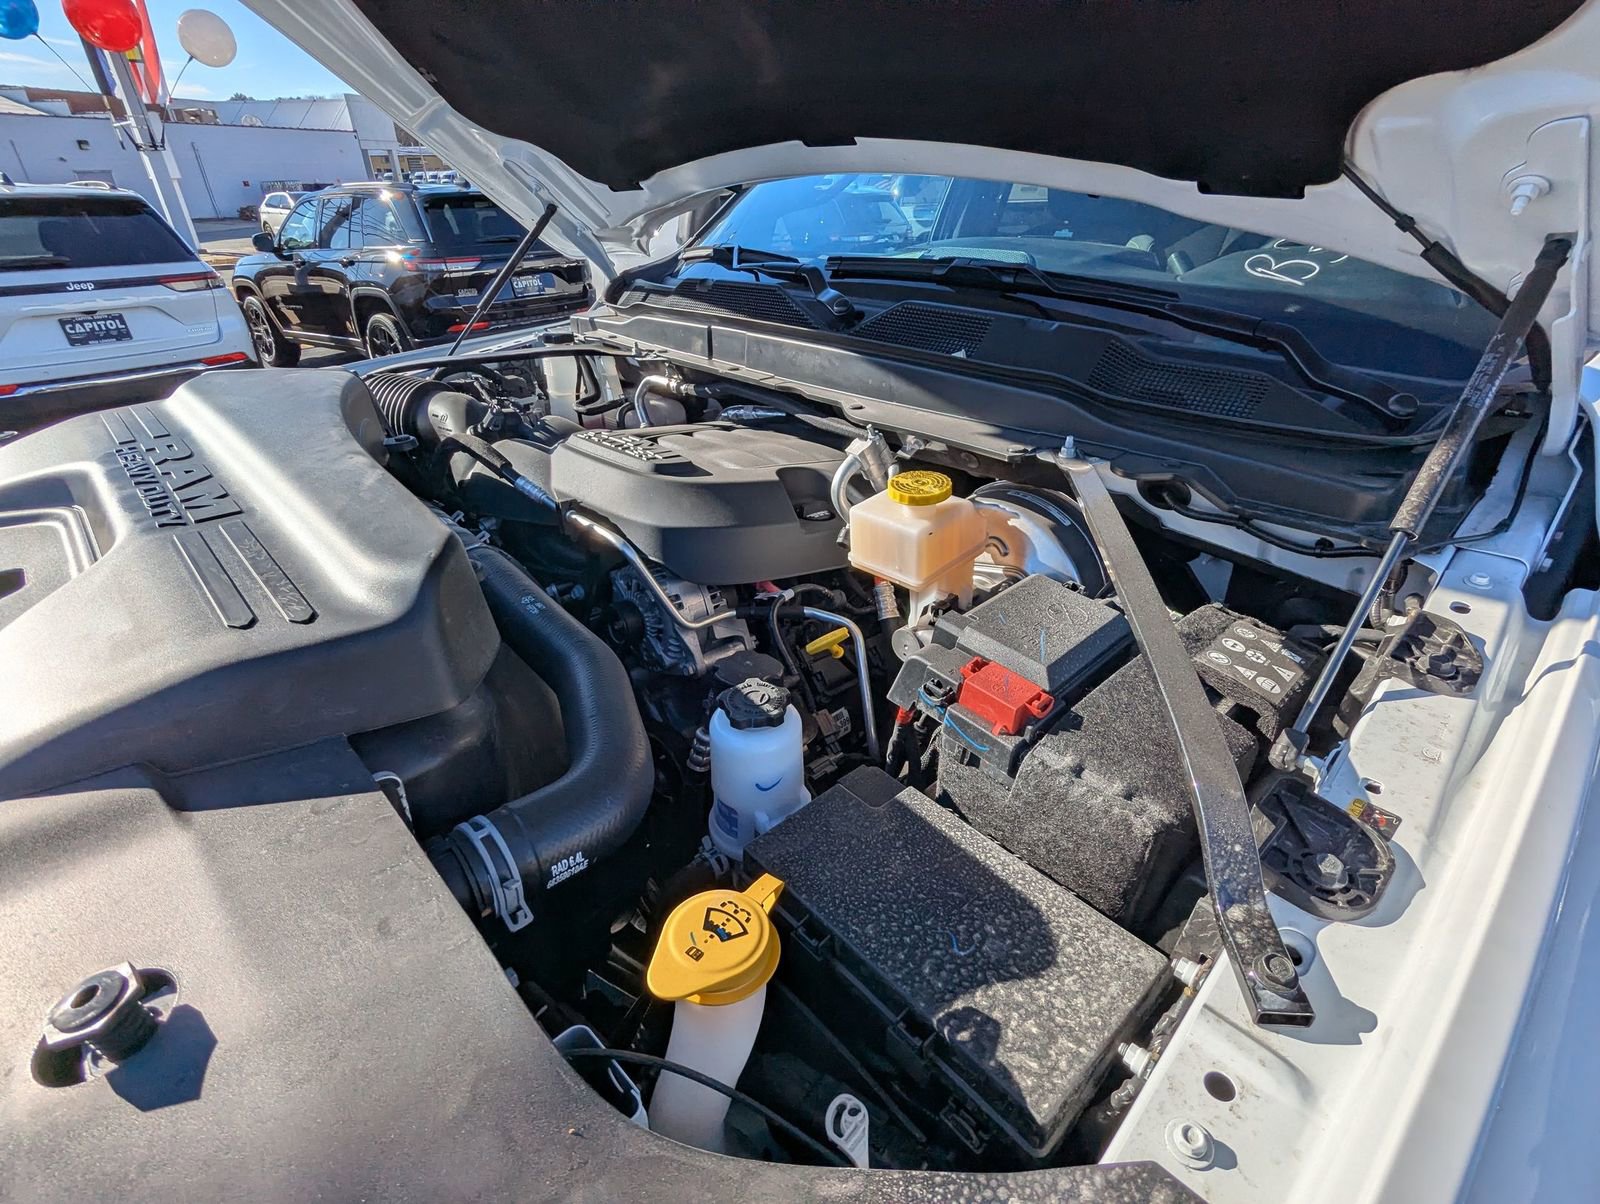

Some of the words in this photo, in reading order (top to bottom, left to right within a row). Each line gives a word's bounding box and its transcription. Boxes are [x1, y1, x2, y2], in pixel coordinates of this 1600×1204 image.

[66, 282, 95, 291] Jeep
[513, 278, 542, 289] CAPITOL
[65, 319, 126, 334] CAPITOL
[114, 447, 160, 486] HEAVY
[140, 438, 244, 525] RAM
[136, 484, 188, 528] DUTY
[551, 858, 569, 877] RAD
